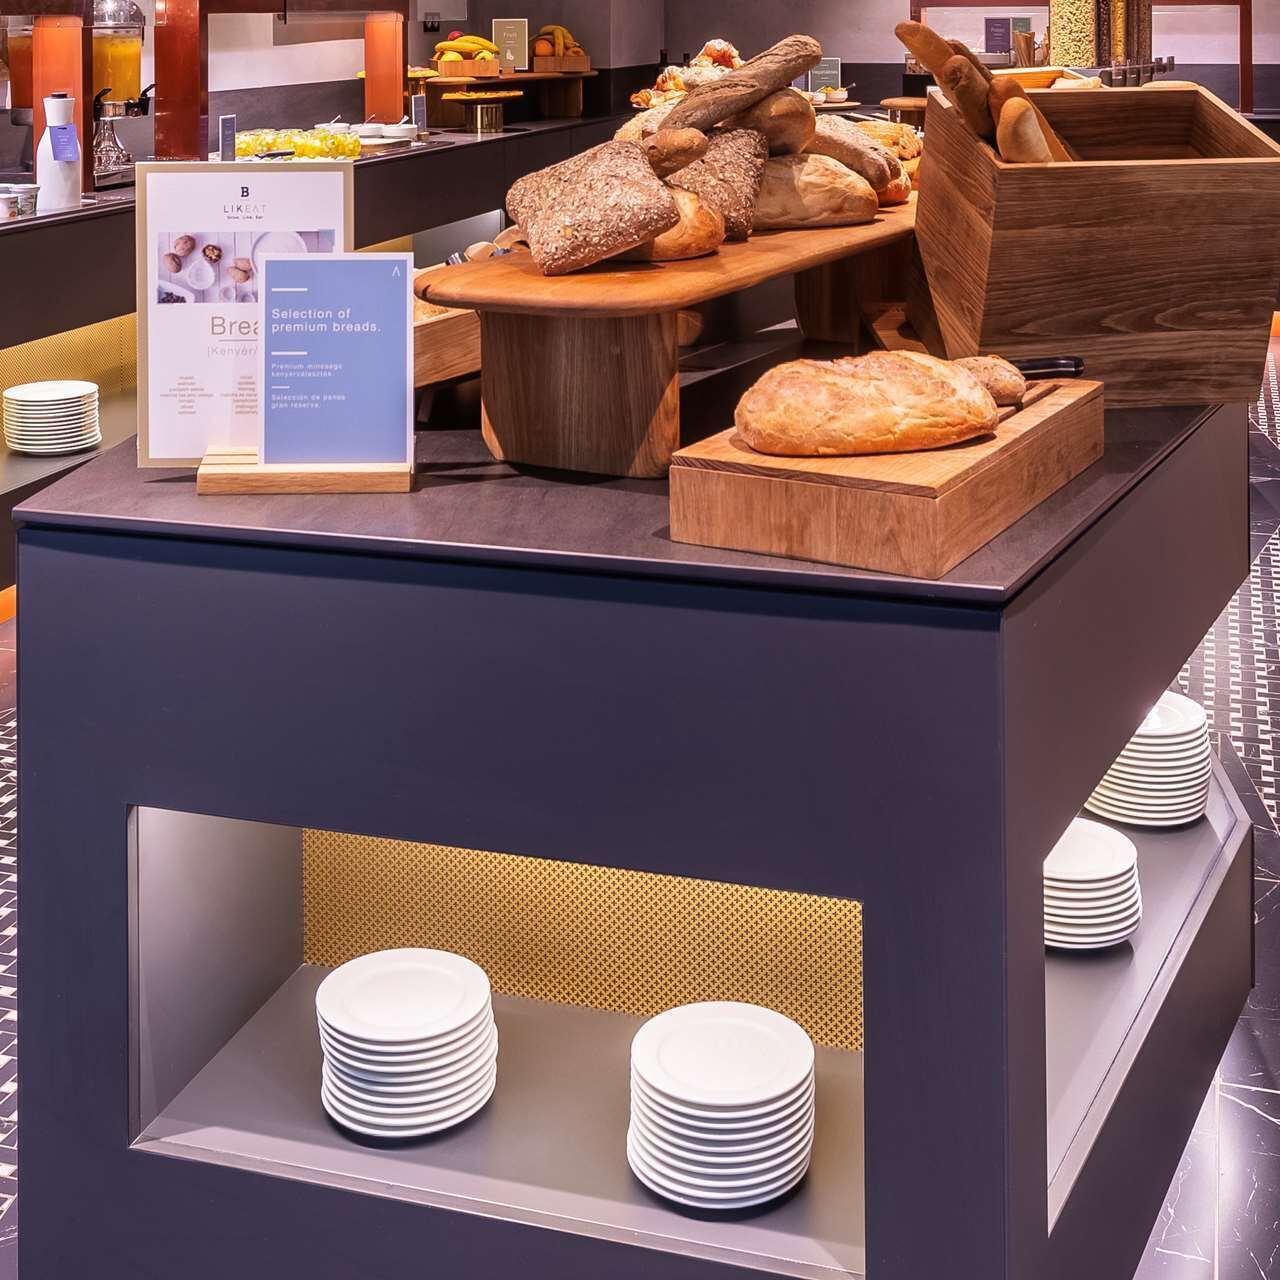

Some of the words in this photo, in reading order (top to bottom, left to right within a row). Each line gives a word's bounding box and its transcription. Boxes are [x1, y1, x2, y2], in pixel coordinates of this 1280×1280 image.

[240, 186, 250, 198] B
[271, 308, 333, 319] Selection
[338, 308, 352, 319] of
[271, 323, 328, 336] premium
[333, 321, 382, 332] breads.
